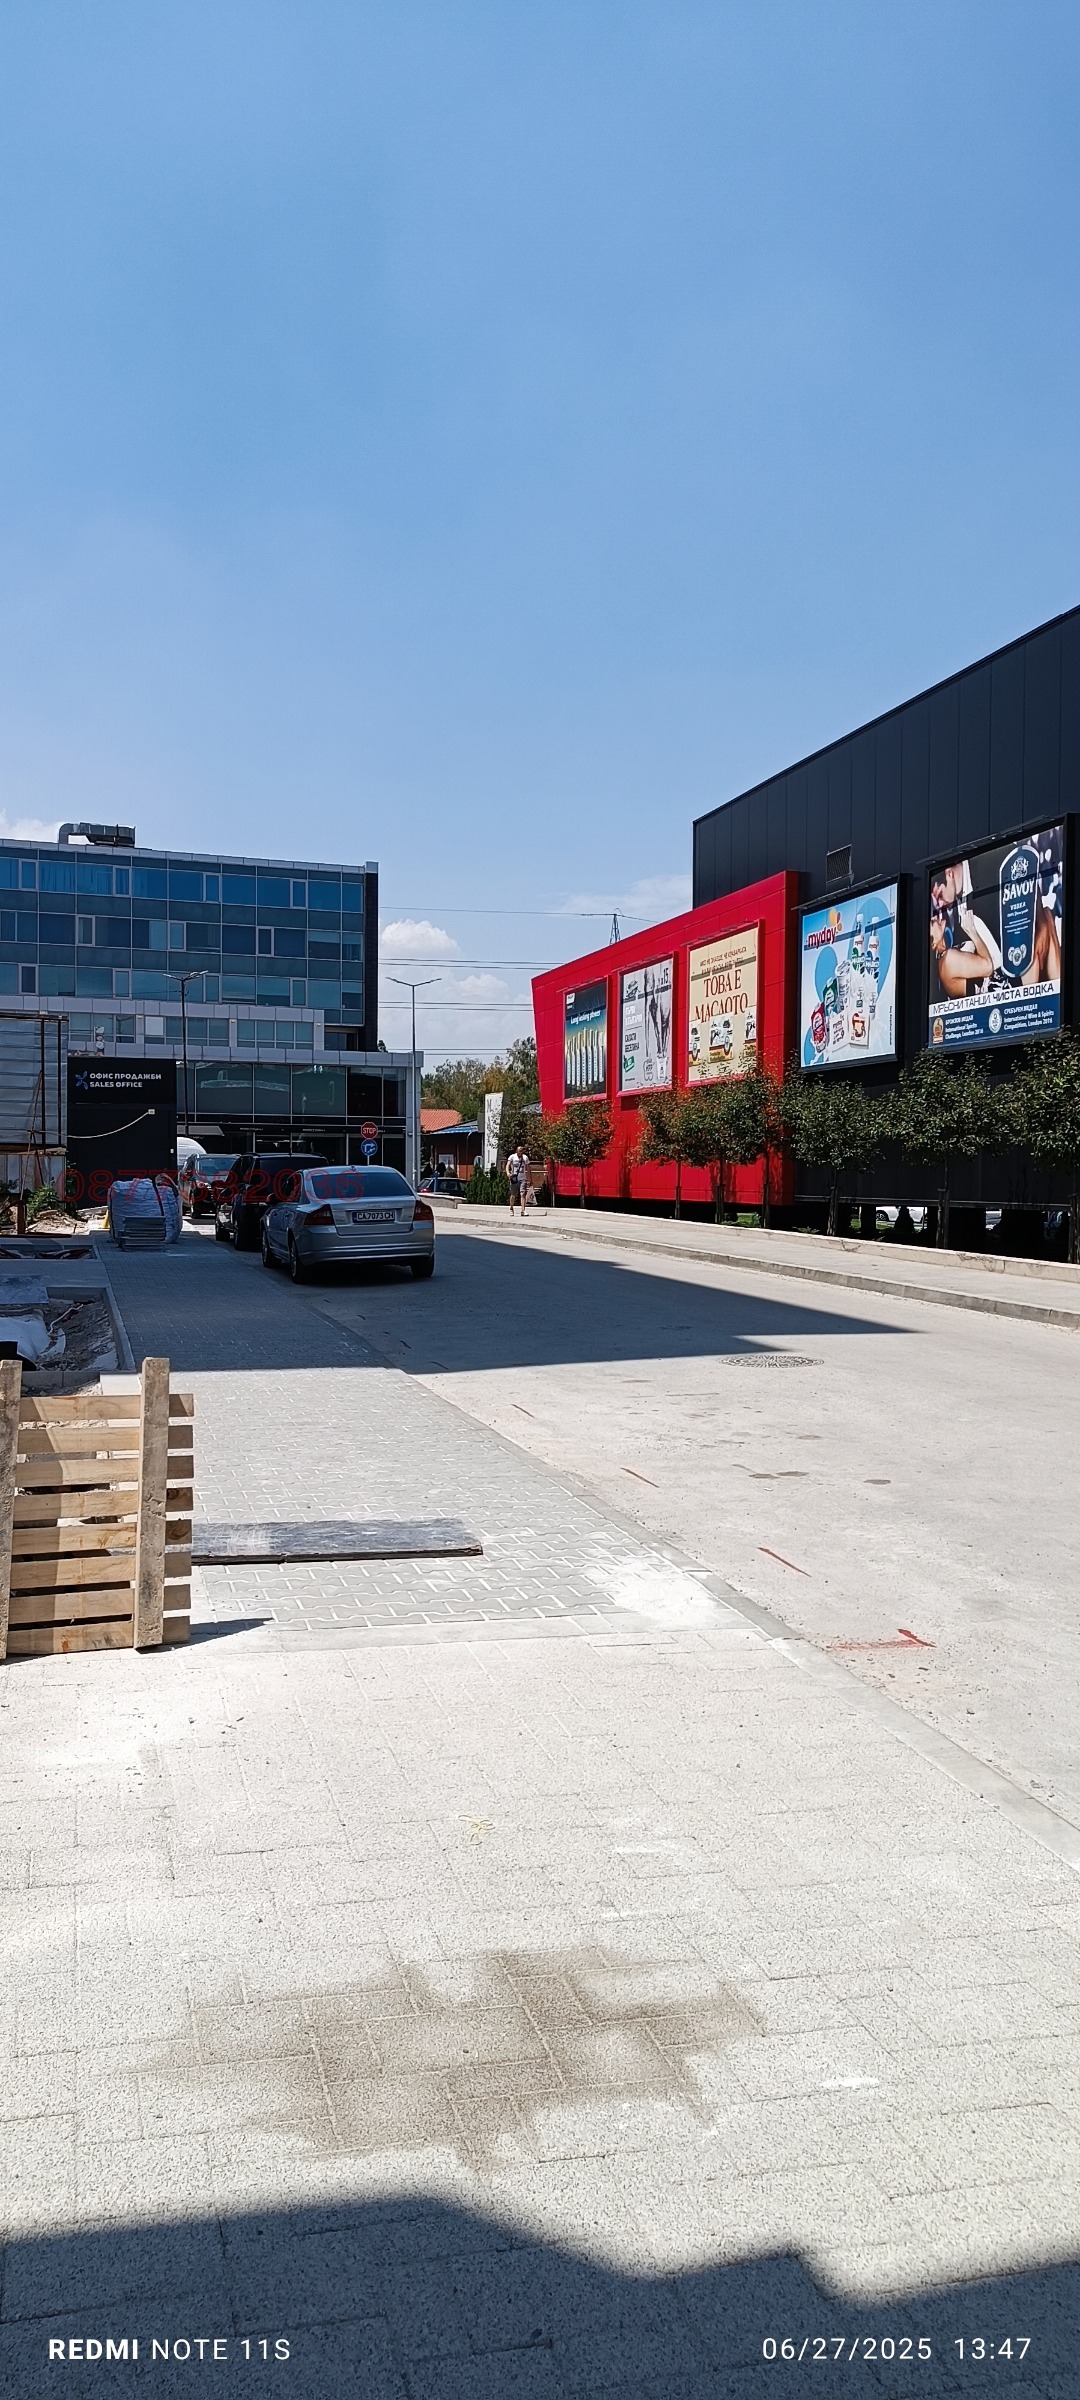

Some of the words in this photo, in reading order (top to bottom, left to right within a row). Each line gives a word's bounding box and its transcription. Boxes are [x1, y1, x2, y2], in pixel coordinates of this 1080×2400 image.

[1002, 877, 1035, 904] SAVOY
[1010, 901, 1026, 911] VODKA
[808, 927, 837, 949] myday
[704, 972, 732, 998] ТОВА
[734, 969, 741, 989] Е
[694, 993, 748, 1023] МАСЛОТО
[933, 1000, 963, 1014] МРЪСНИ
[992, 989, 1021, 1002] ЧИСТА
[1023, 983, 1055, 997] ВОДКА
[89, 1072, 114, 1080] ОФИС
[114, 1073, 162, 1081] ПРОДАЖБИ
